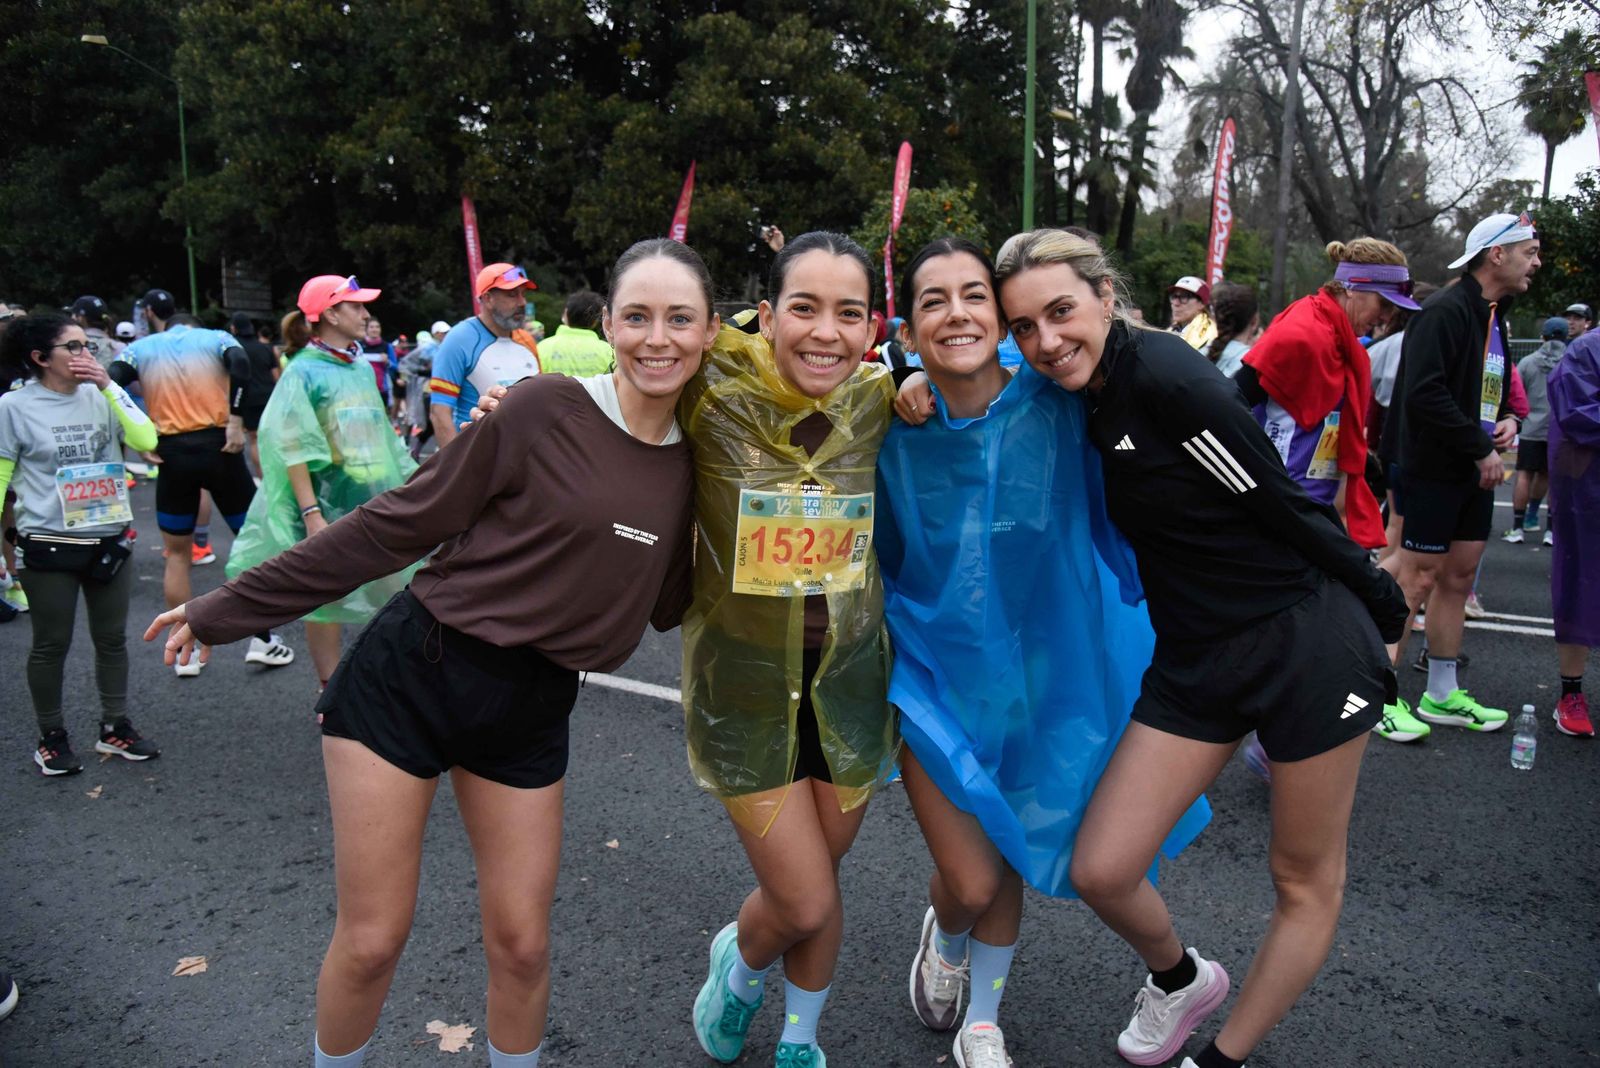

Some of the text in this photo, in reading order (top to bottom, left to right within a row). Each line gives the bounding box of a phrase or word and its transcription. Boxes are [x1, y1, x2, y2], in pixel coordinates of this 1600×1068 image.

[58, 445, 77, 457] POR
[64, 478, 116, 501] 22253
[750, 525, 854, 565] 15234
